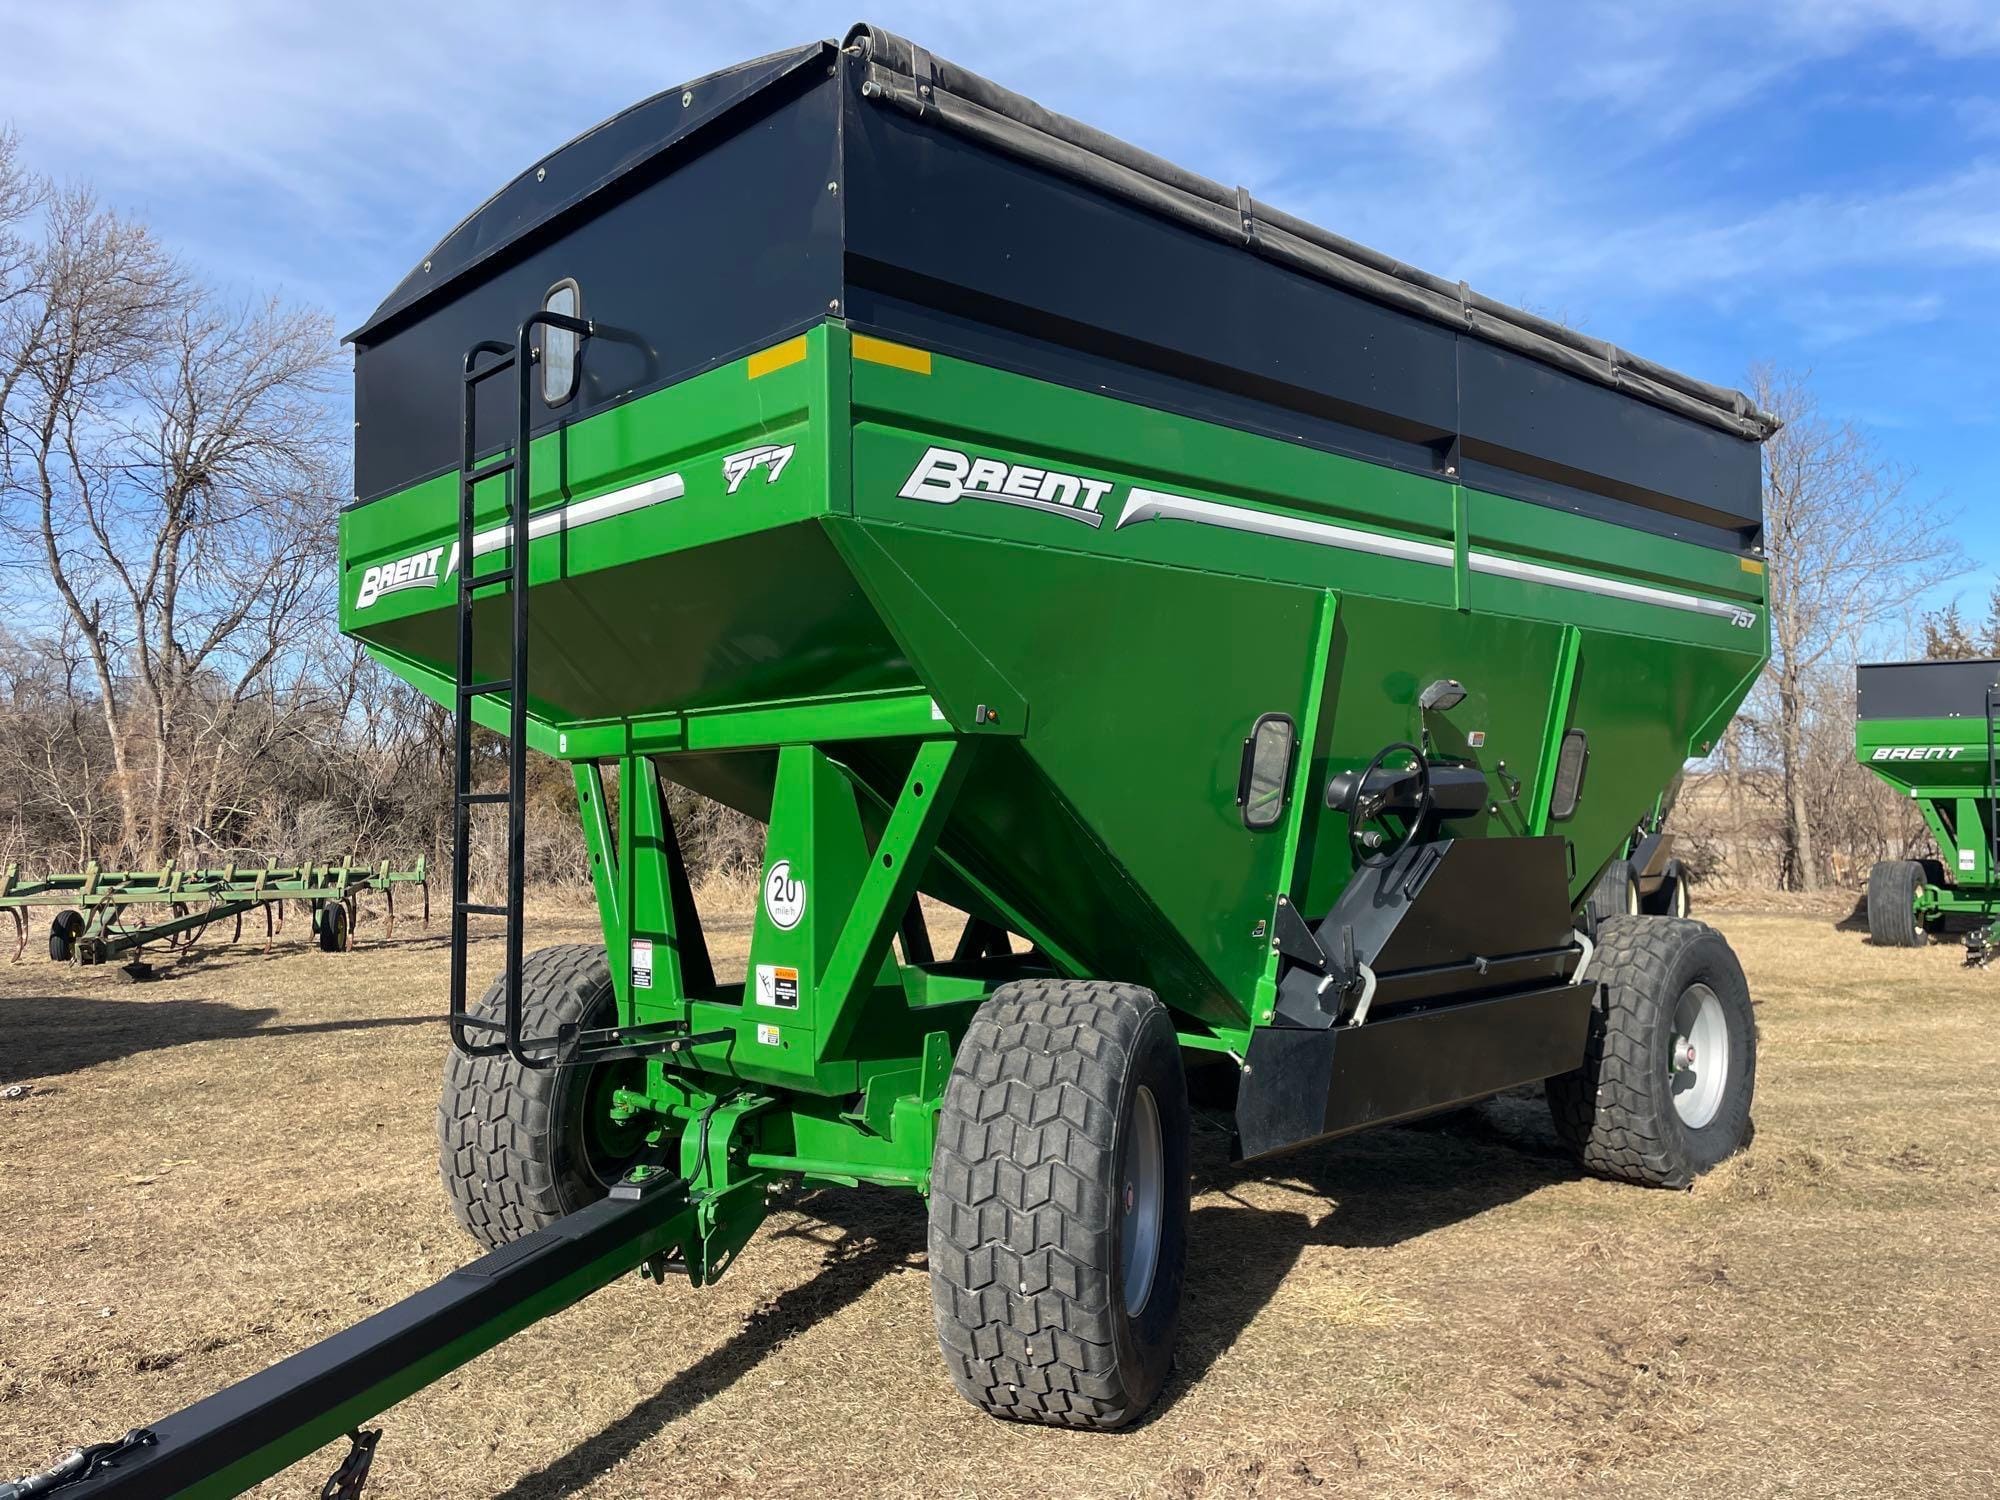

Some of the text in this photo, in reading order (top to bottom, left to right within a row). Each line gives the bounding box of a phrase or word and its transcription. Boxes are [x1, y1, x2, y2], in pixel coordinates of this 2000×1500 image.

[897, 446, 1114, 516] BRENT
[355, 545, 444, 611] BRENT
[1731, 609, 1757, 629] 757
[1872, 747, 1965, 760] BRENT
[774, 875, 796, 902] 20
